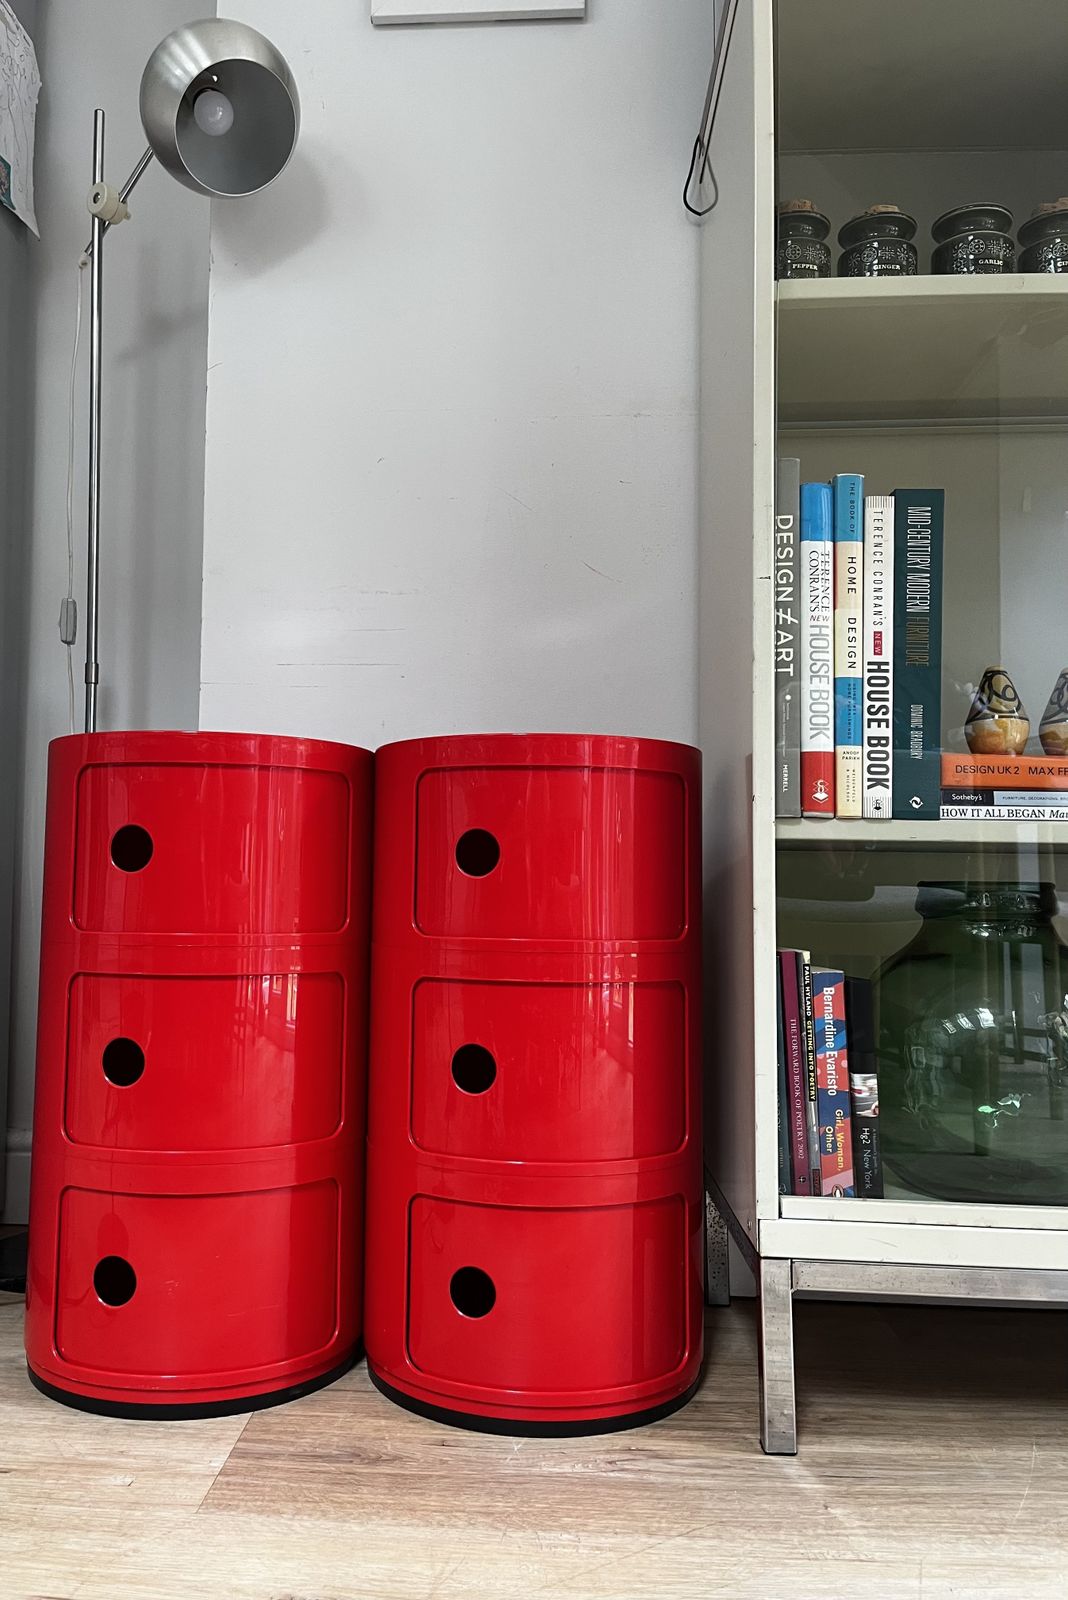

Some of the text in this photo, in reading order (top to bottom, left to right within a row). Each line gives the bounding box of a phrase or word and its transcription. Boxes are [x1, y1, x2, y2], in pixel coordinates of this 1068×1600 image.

[849, 524, 855, 533] OF
[777, 515, 794, 602] DESIGN
[809, 550, 820, 612] CONRAN'S
[821, 551, 830, 612] TERENCE
[873, 510, 884, 626] TERENCE CONRAN'S
[906, 506, 931, 667] MID-CENTURY MODERN FURNITURE
[848, 556, 857, 669] HOME DESIGN
[777, 630, 794, 677] ART
[874, 632, 882, 656] NEW
[809, 625, 830, 740] HOUSE BOOK
[867, 661, 889, 790] HOUSE BOOK
[910, 704, 923, 760] DOMINIC BRADBURY
[951, 793, 983, 802] Sotheby's
[955, 765, 995, 774] DESIGN
[997, 766, 1012, 774] UK
[1014, 766, 1020, 775] 2
[1028, 766, 1054, 776] MAX
[941, 808, 968, 817] HOW
[971, 808, 983, 817] IT
[985, 808, 1005, 818] ALL
[1007, 809, 1045, 818] BEGAN
[791, 1035, 800, 1075] FORWARD
[823, 987, 838, 1096] Bernardine Evaristo
[793, 1075, 801, 1097] BOOK
[795, 1099, 802, 1109] OF
[795, 1111, 804, 1141] POETRY
[825, 1126, 835, 1153] Other
[835, 1109, 845, 1171] Girl, Woman,
[860, 1128, 873, 1189] Hg2 New York
